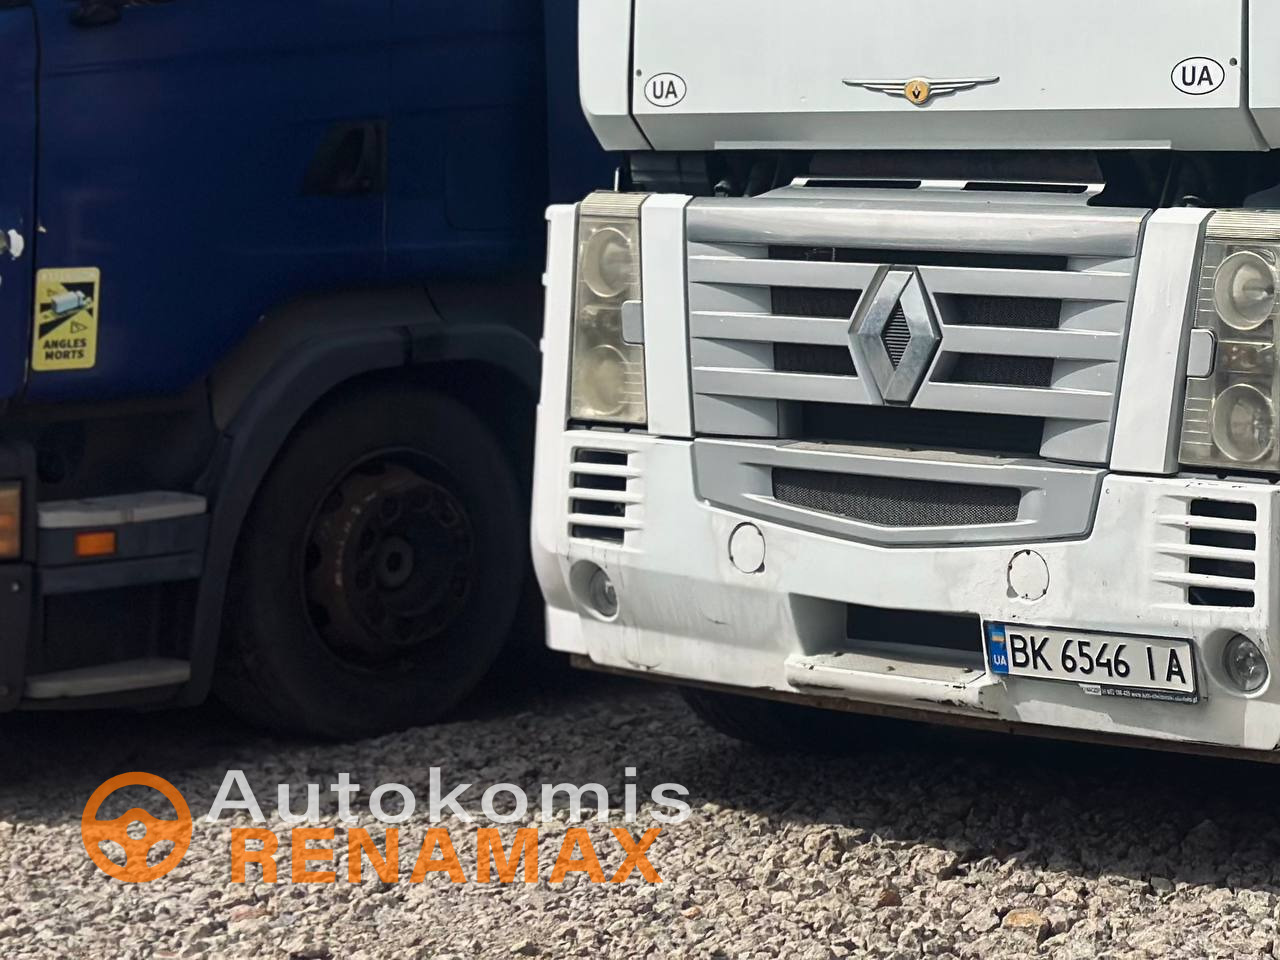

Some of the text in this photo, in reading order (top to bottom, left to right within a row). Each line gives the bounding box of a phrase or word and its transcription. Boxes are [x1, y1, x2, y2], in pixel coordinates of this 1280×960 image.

[1182, 65, 1214, 86] UA
[653, 80, 678, 99] UA
[43, 338, 87, 350] ANGLES
[45, 349, 85, 361] MORTS
[993, 654, 1008, 667] UA
[1009, 633, 1053, 672] BK
[1061, 639, 1131, 678] 6546
